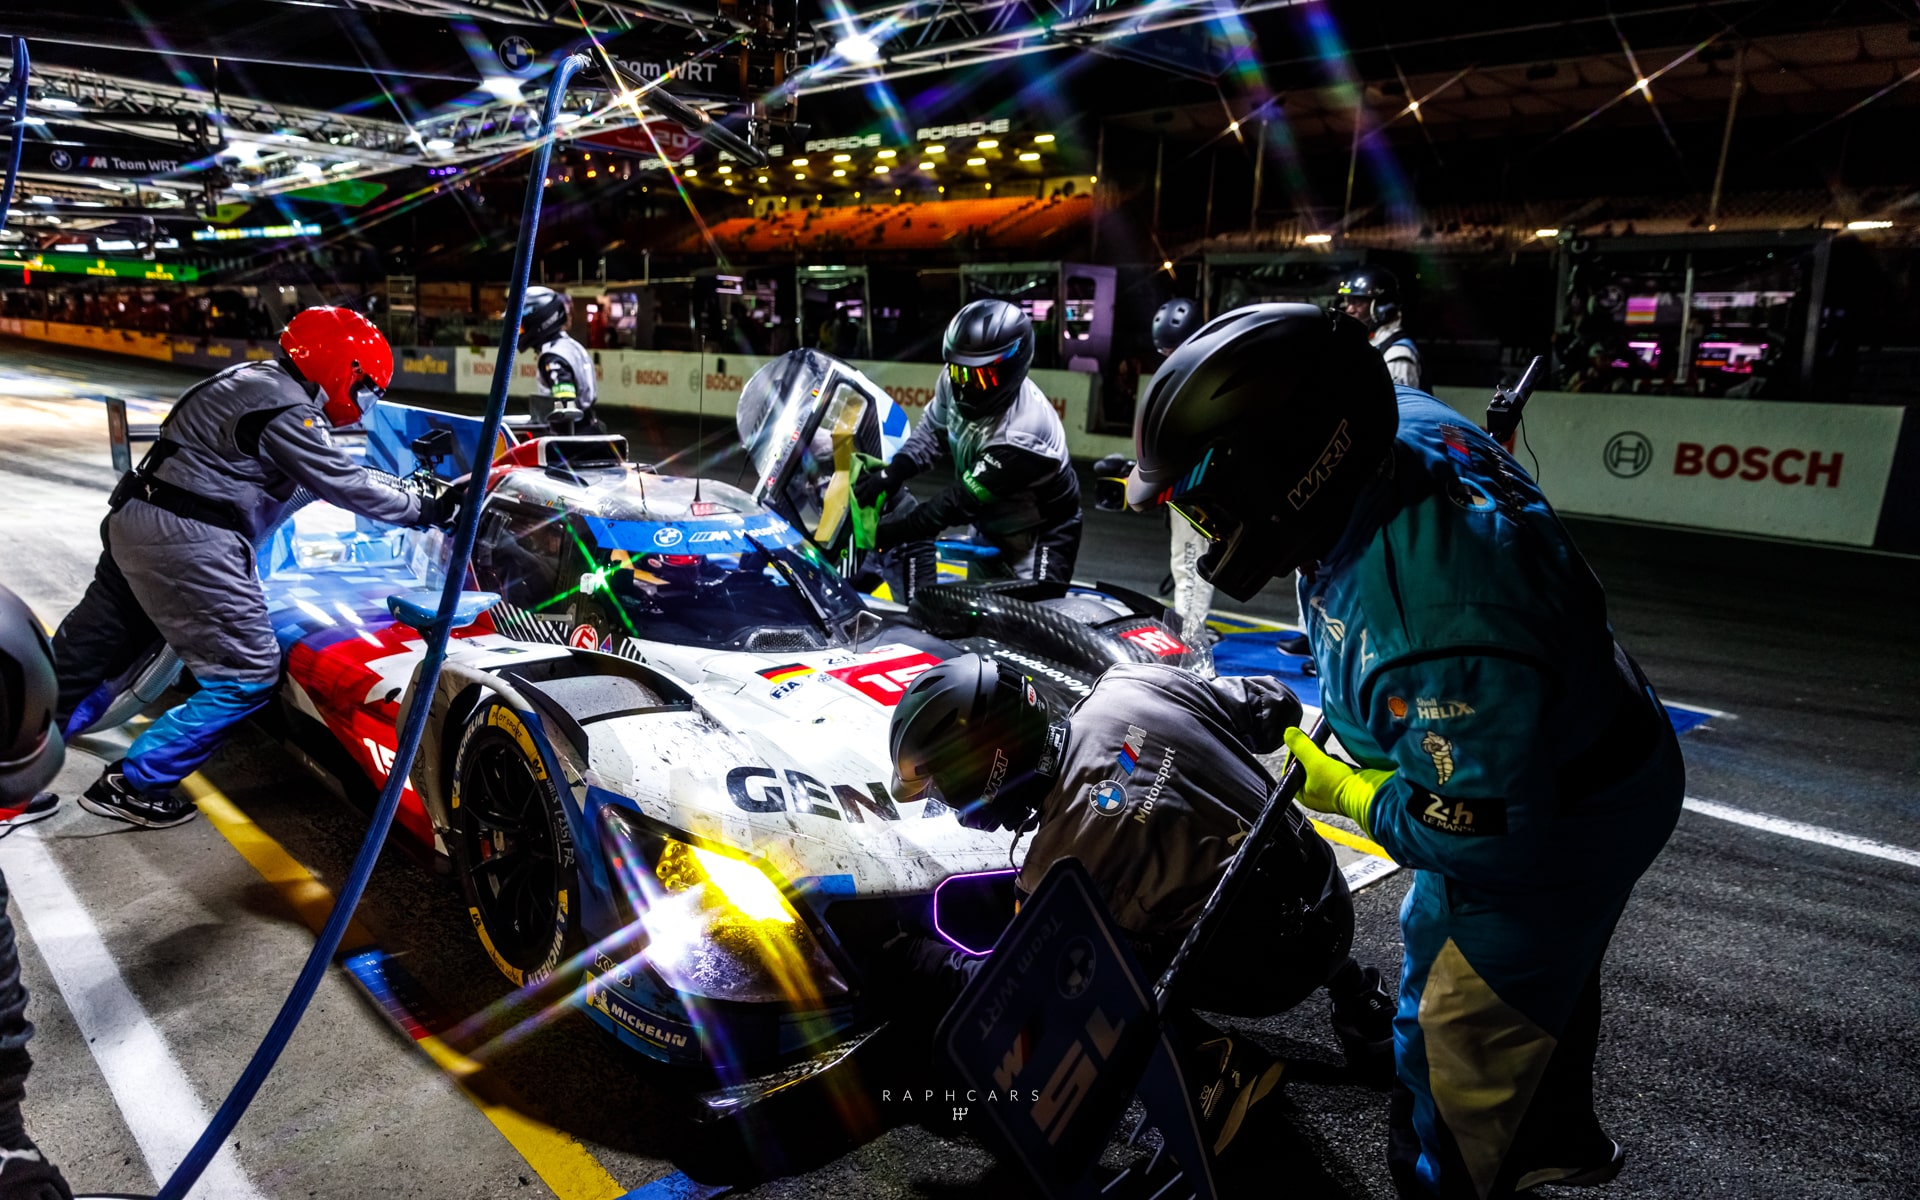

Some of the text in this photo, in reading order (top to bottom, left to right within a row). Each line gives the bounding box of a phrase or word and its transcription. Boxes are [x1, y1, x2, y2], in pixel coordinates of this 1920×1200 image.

[666, 59, 718, 83] WRT
[916, 118, 1010, 142] PORSCHE
[805, 133, 882, 153] PORSCHE
[111, 157, 146, 171] Team
[148, 159, 179, 173] WRT
[635, 369, 669, 386] BOSCH
[705, 373, 743, 391] BOSCH
[1287, 418, 1352, 511] WRT
[1673, 441, 1844, 488] BOSCH
[1416, 701, 1476, 721] HELIX
[1133, 745, 1178, 825] Motorsport
[610, 1003, 688, 1048] MICHELIN
